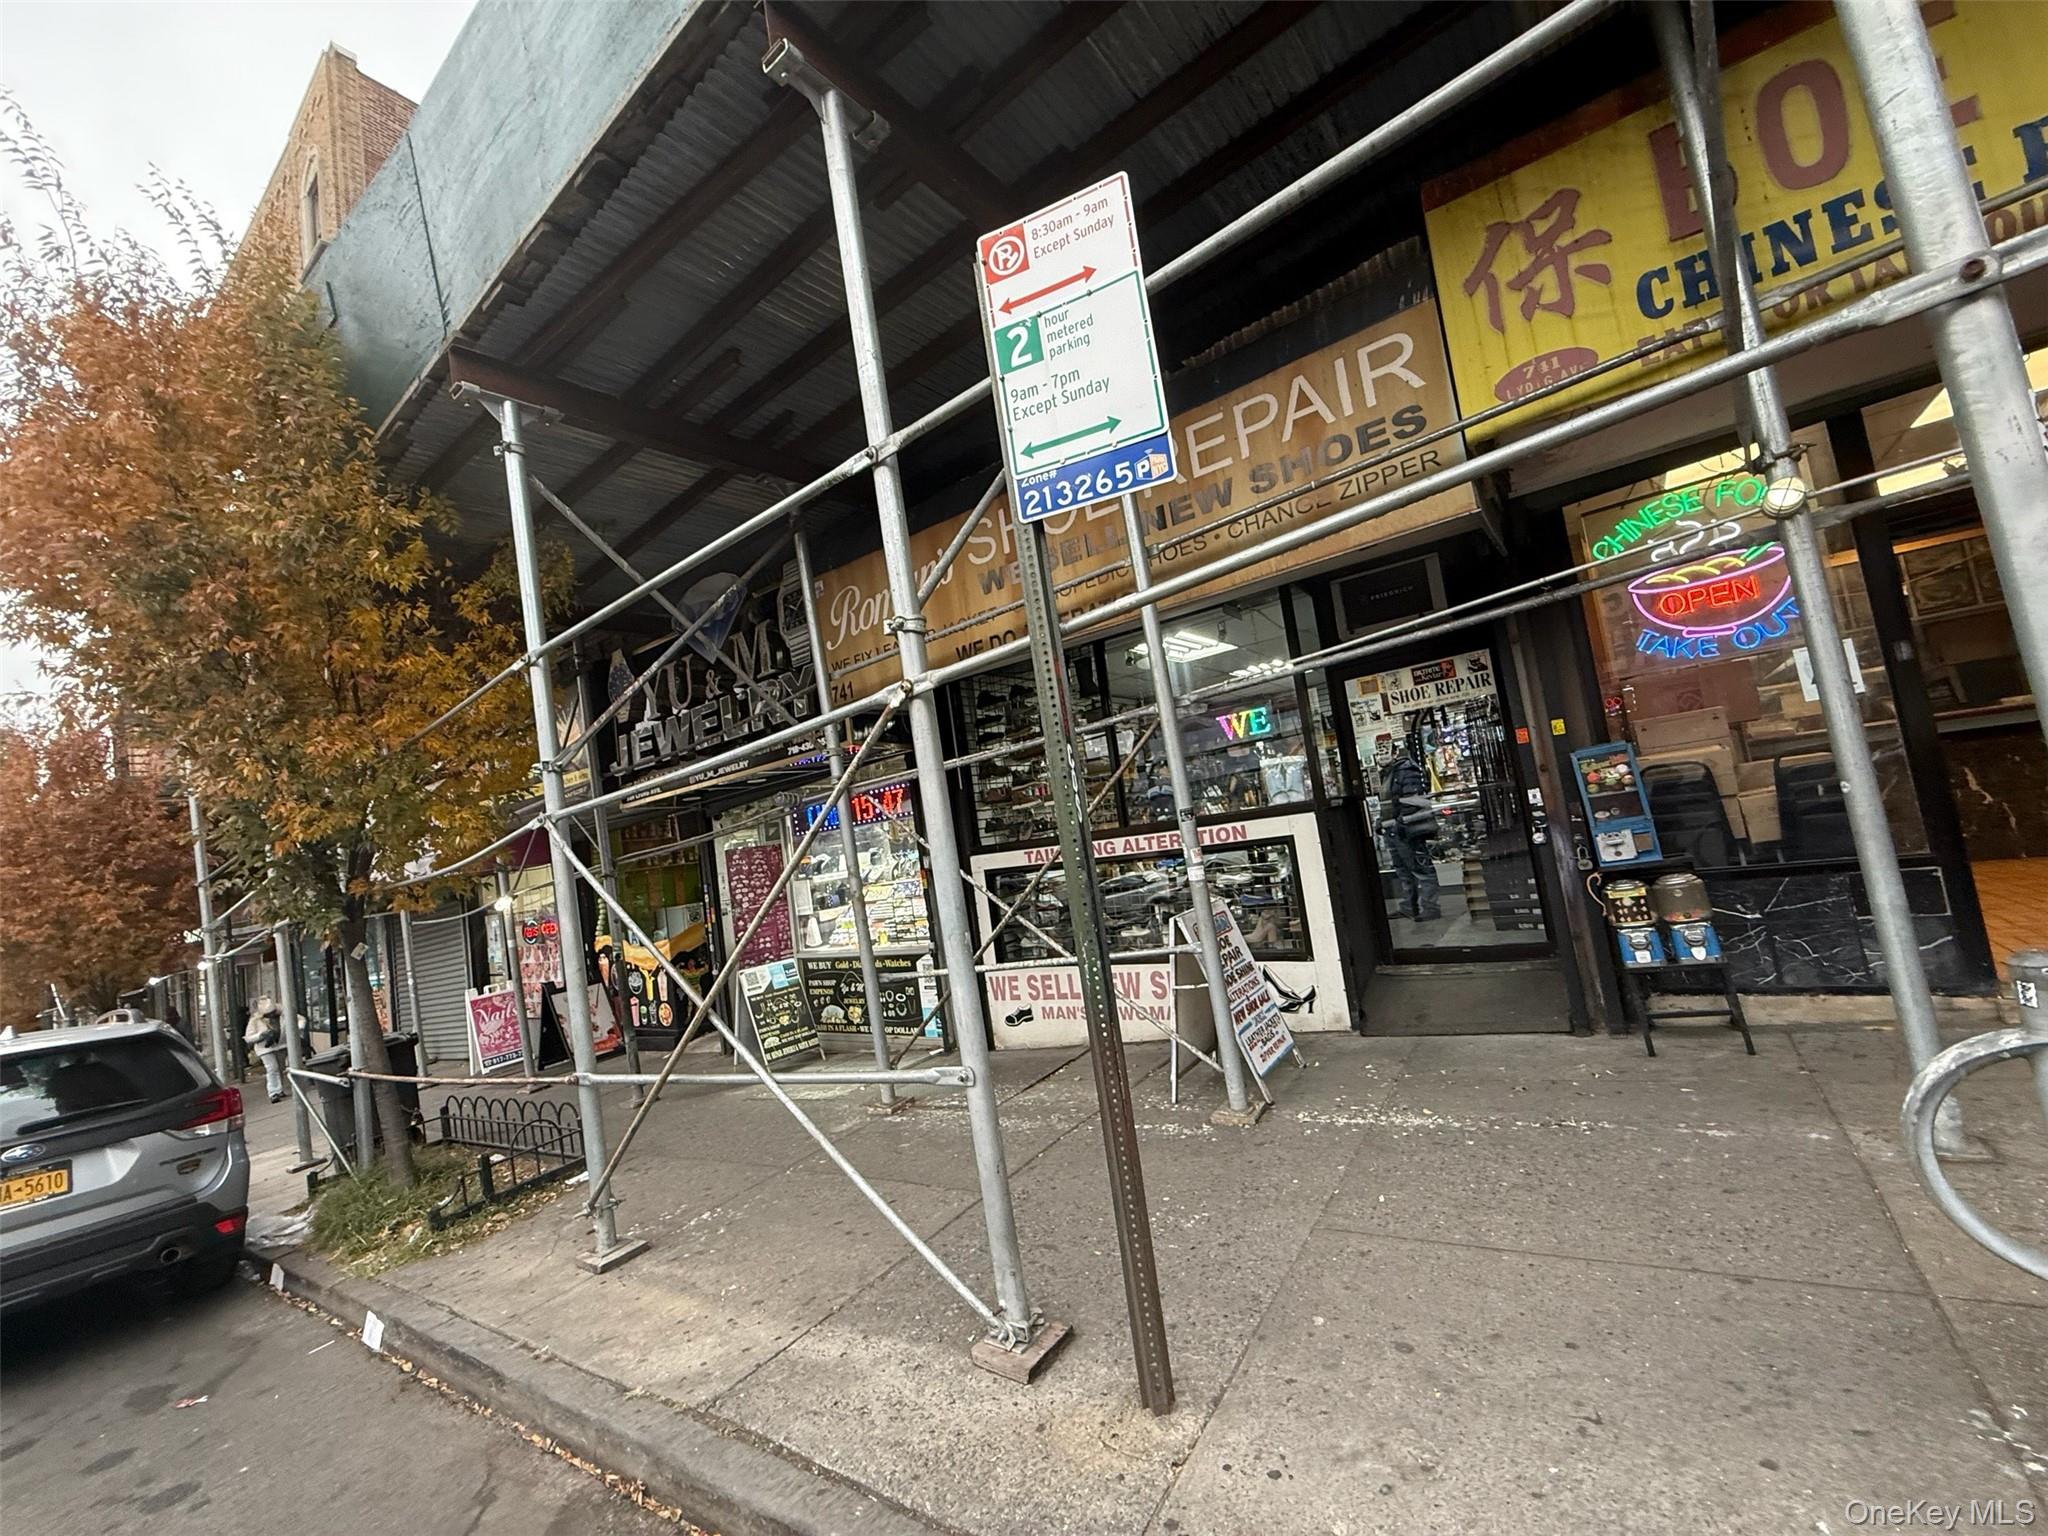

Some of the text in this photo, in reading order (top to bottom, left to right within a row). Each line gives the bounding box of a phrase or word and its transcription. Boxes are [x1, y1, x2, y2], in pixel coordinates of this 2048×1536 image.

[1031, 213, 1074, 241] 8:30am
[1082, 197, 1108, 221] 9am
[1033, 214, 1115, 260] Except Sunday
[1464, 187, 1613, 335] 保
[1007, 309, 1070, 369] 2 hour
[1046, 313, 1095, 343] metered
[1049, 333, 1091, 360] parking
[1010, 382, 1040, 404] 9am
[1051, 368, 1081, 395] 7pm
[1012, 376, 1111, 422] Except Sunday
[1144, 332, 1427, 498] EPAIR
[1249, 404, 1427, 494] SHOES
[1021, 469, 1057, 488] Zone#
[1024, 460, 1134, 516] 213265
[1338, 449, 1442, 502] ZIPPER
[1592, 486, 1705, 561] CHINESE
[1659, 575, 1760, 616] OPEN
[1636, 596, 1802, 659] TAKE OUT
[832, 681, 854, 703] 741
[1390, 686, 1431, 706] SHOE
[1435, 672, 1492, 697] REPAIR
[609, 663, 816, 776] JEWELRY
[1216, 707, 1271, 741] WE
[1123, 824, 1248, 853] ALTERTION
[819, 961, 831, 969] BUY
[988, 975, 1025, 1001] WE
[1028, 973, 1082, 1001] SELL
[474, 1001, 518, 1025] Nails
